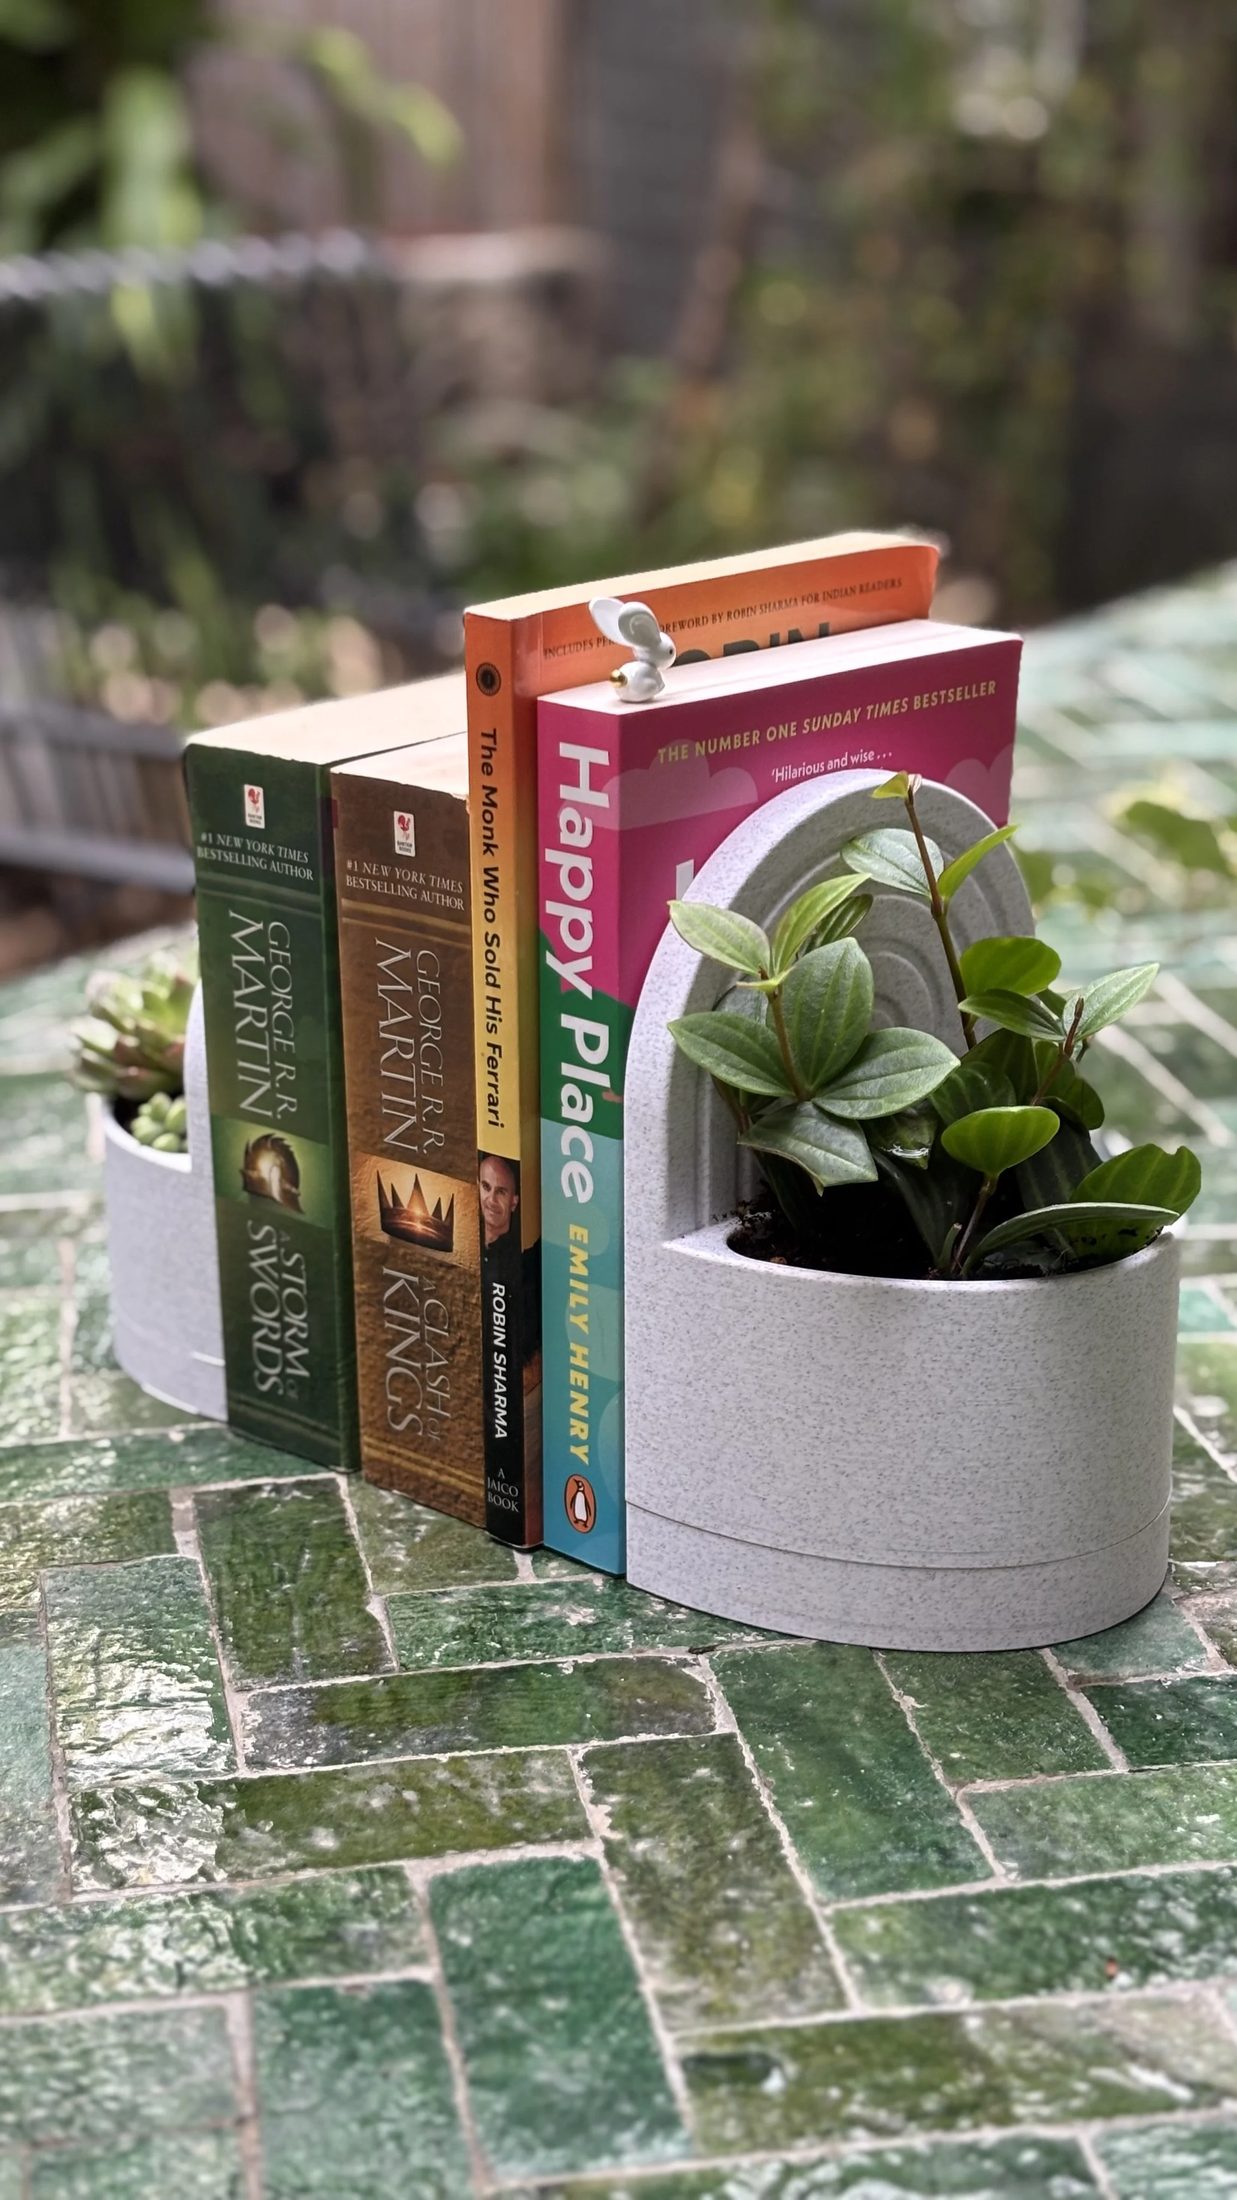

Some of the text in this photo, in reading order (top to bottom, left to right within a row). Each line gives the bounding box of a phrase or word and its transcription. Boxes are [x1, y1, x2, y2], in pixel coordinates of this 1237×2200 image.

[543, 639, 594, 660] INCLUDES
[661, 615, 709, 633] OREWORD
[712, 612, 724, 624] BY
[726, 606, 758, 621] ROBIN
[759, 597, 799, 614] SHARMA
[801, 592, 820, 607] FOR
[822, 585, 857, 602] INDIAN
[859, 577, 903, 595] READERS
[658, 680, 996, 764] THE NUMBER ONE SUNDAY TIMES BESTSELLER
[827, 752, 848, 770] and
[196, 846, 314, 880] BESTSELLING AUTHOR
[201, 832, 310, 864] #1 NEW YORK TIMES
[345, 874, 465, 911] BESTSELLING AUTHOR
[346, 860, 464, 893] #1 NEW YORK TIMES
[268, 921, 297, 1054] GEORGE
[480, 728, 505, 1129] The Monk Who Sold His Ferrari
[545, 741, 611, 1204] Happy Place
[228, 909, 274, 1119] MARTIN
[375, 936, 419, 1153] MARTIN
[416, 949, 444, 1088] GEORGE
[247, 1219, 284, 1396] SWORDS
[280, 1247, 311, 1378] STORM
[382, 1265, 424, 1437] KINGS
[424, 1298, 452, 1418] CLASH
[492, 1282, 508, 1439] ROBIN SHARMA
[568, 1223, 590, 1466] EMILY HENRY
[488, 1491, 519, 1512] BOOK
